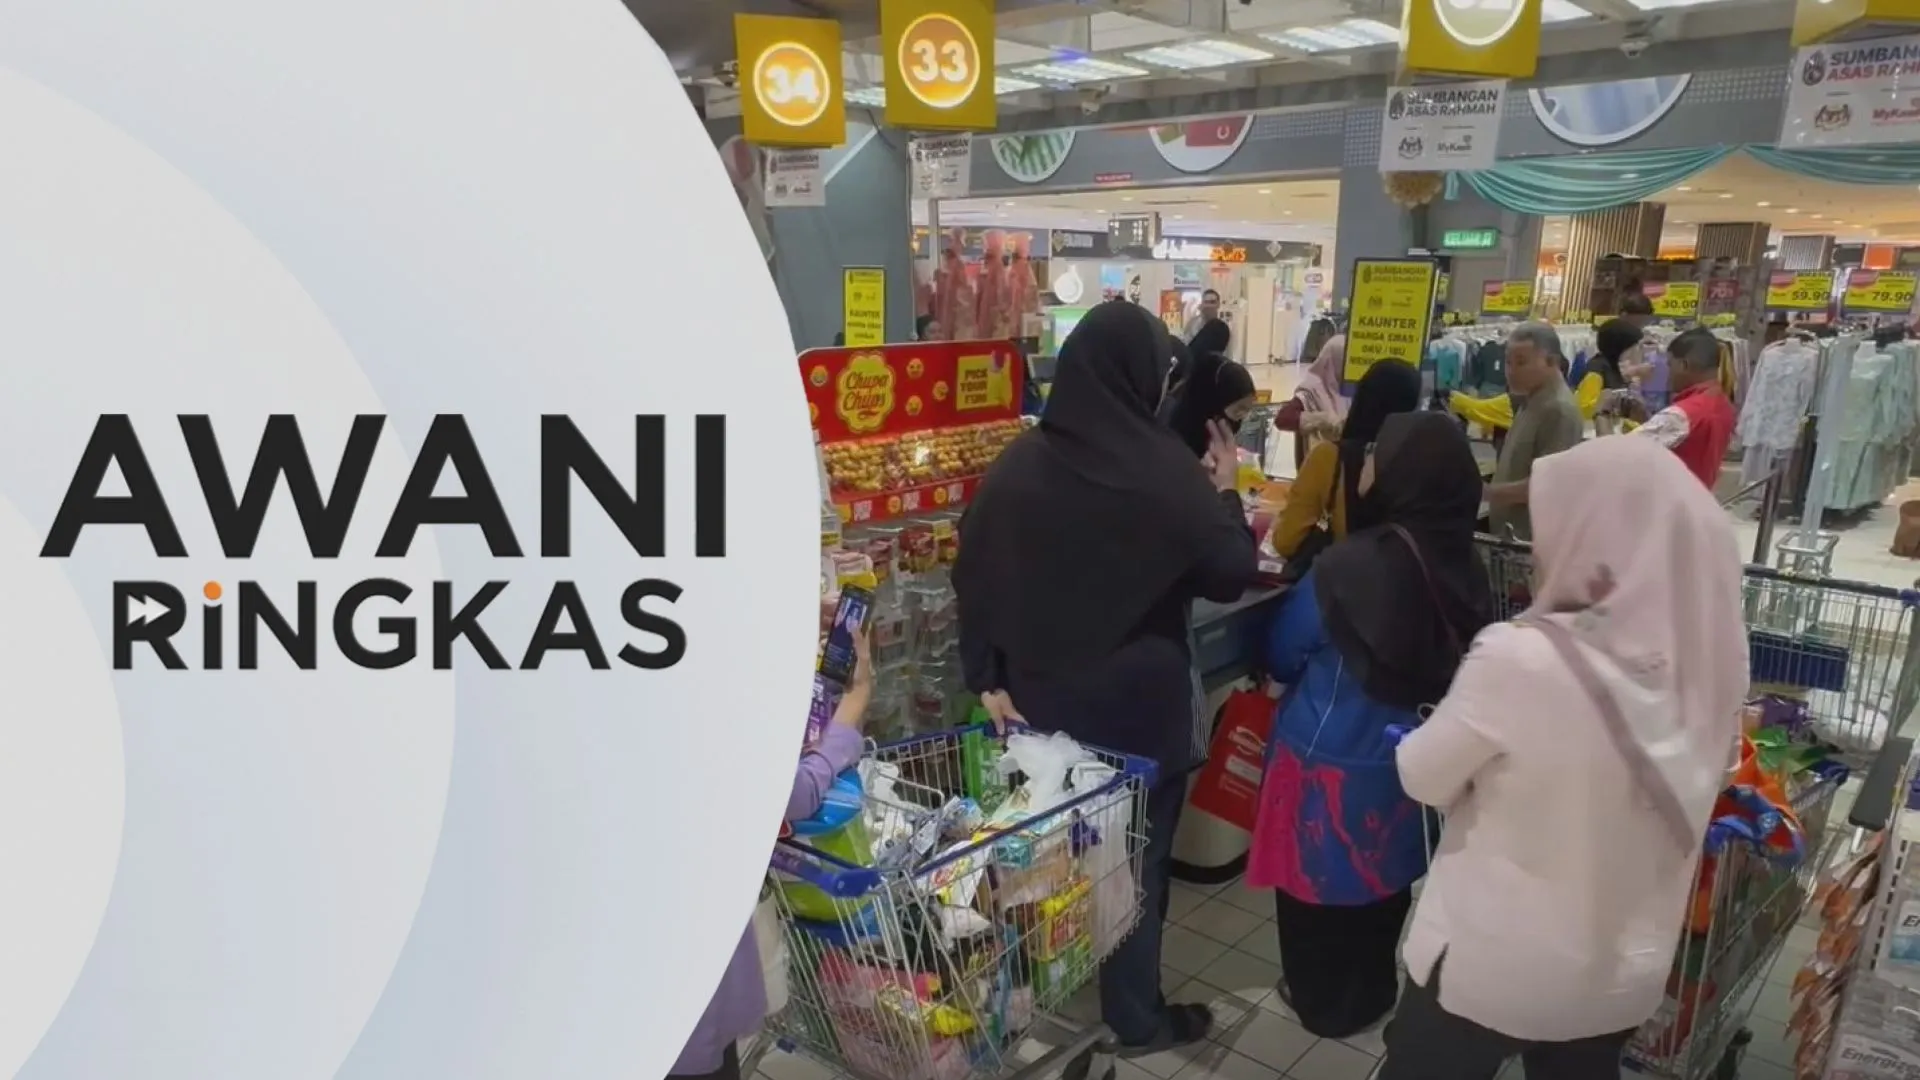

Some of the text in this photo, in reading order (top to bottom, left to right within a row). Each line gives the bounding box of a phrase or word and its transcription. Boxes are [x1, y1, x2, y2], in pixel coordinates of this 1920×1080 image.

[911, 39, 969, 82] 33
[1830, 45, 1920, 66] SUMBAN
[1827, 61, 1920, 81] ASAS RAH
[765, 64, 820, 104] 34
[1407, 89, 1498, 105] SUMBANGAN
[1406, 103, 1496, 117] ASAS RAHMAH
[1871, 291, 1914, 302] 79.90
[1358, 316, 1417, 329] KAUNTER
[845, 371, 889, 388] Chupa
[842, 389, 886, 411] Chups
